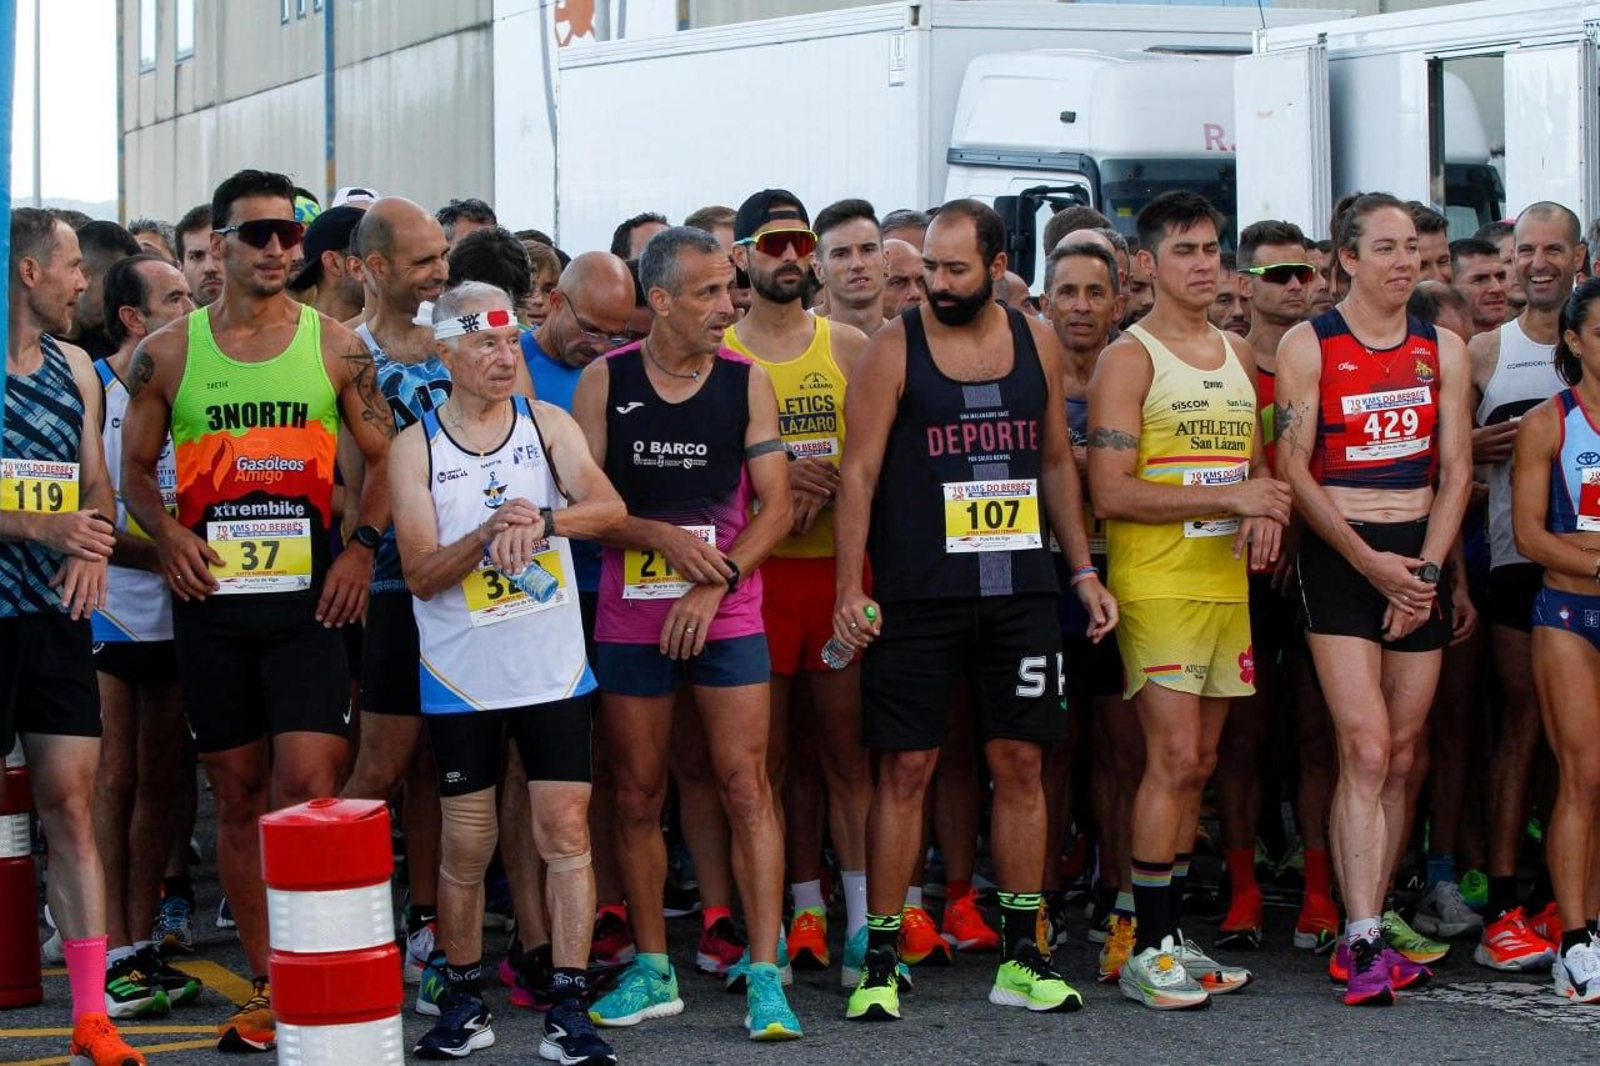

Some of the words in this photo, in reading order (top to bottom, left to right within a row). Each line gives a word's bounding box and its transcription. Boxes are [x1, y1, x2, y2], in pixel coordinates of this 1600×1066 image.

[1203, 123, 1236, 151] R.
[1362, 397, 1381, 406] KMS
[1382, 394, 1396, 402] DO
[205, 401, 308, 430] 3NORTH
[780, 416, 835, 434] LÁZARO
[1363, 408, 1419, 440] 429
[926, 420, 1038, 457] DEPORTE
[1191, 436, 1212, 450] San
[1214, 437, 1246, 452] Lázaro
[633, 440, 645, 453] O
[649, 441, 708, 456] BARCO
[15, 463, 31, 471] KMS
[32, 463, 45, 471] DO
[236, 455, 305, 471] Gasóleos
[233, 470, 284, 485] Amigo
[1203, 471, 1222, 479] KMS
[14, 480, 63, 512] 119
[965, 483, 985, 493] KMS
[986, 483, 1001, 492] DO
[213, 501, 305, 518] xtrembike
[966, 500, 1020, 530] 107
[229, 524, 250, 533] KMS
[252, 522, 267, 531] DO
[240, 541, 280, 571] 37
